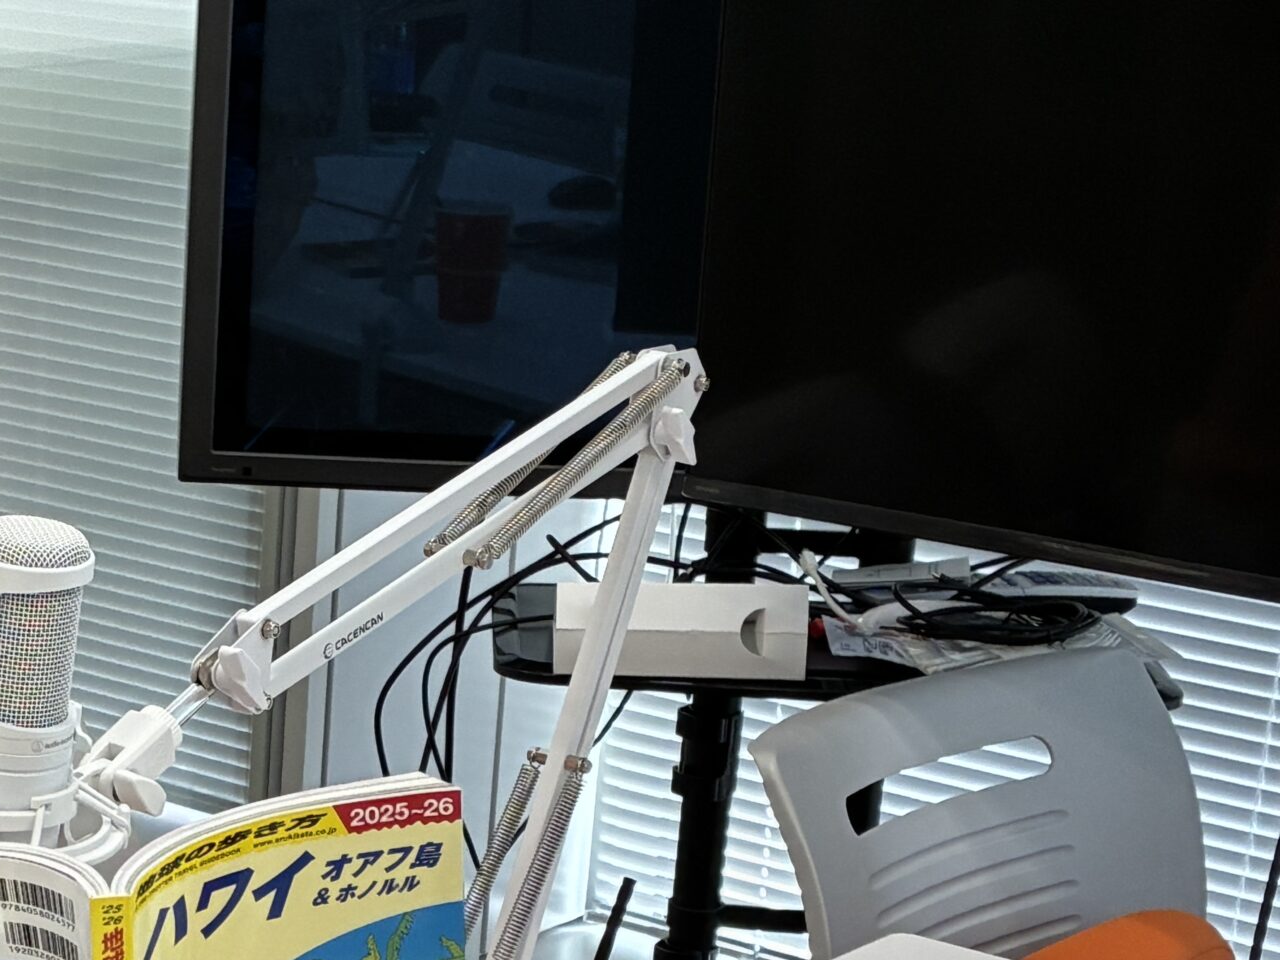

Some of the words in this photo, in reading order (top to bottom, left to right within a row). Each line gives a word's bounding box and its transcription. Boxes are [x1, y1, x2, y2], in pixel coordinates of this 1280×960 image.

[335, 612, 384, 651] CACENCAN
[350, 798, 454, 828] 2025~26
[136, 812, 327, 897] 地球の歩き方
[253, 827, 337, 849] www.arukikata.co.jp
[321, 841, 444, 882] オアフ島
[312, 887, 331, 907] &
[336, 875, 421, 903] ホノルル
